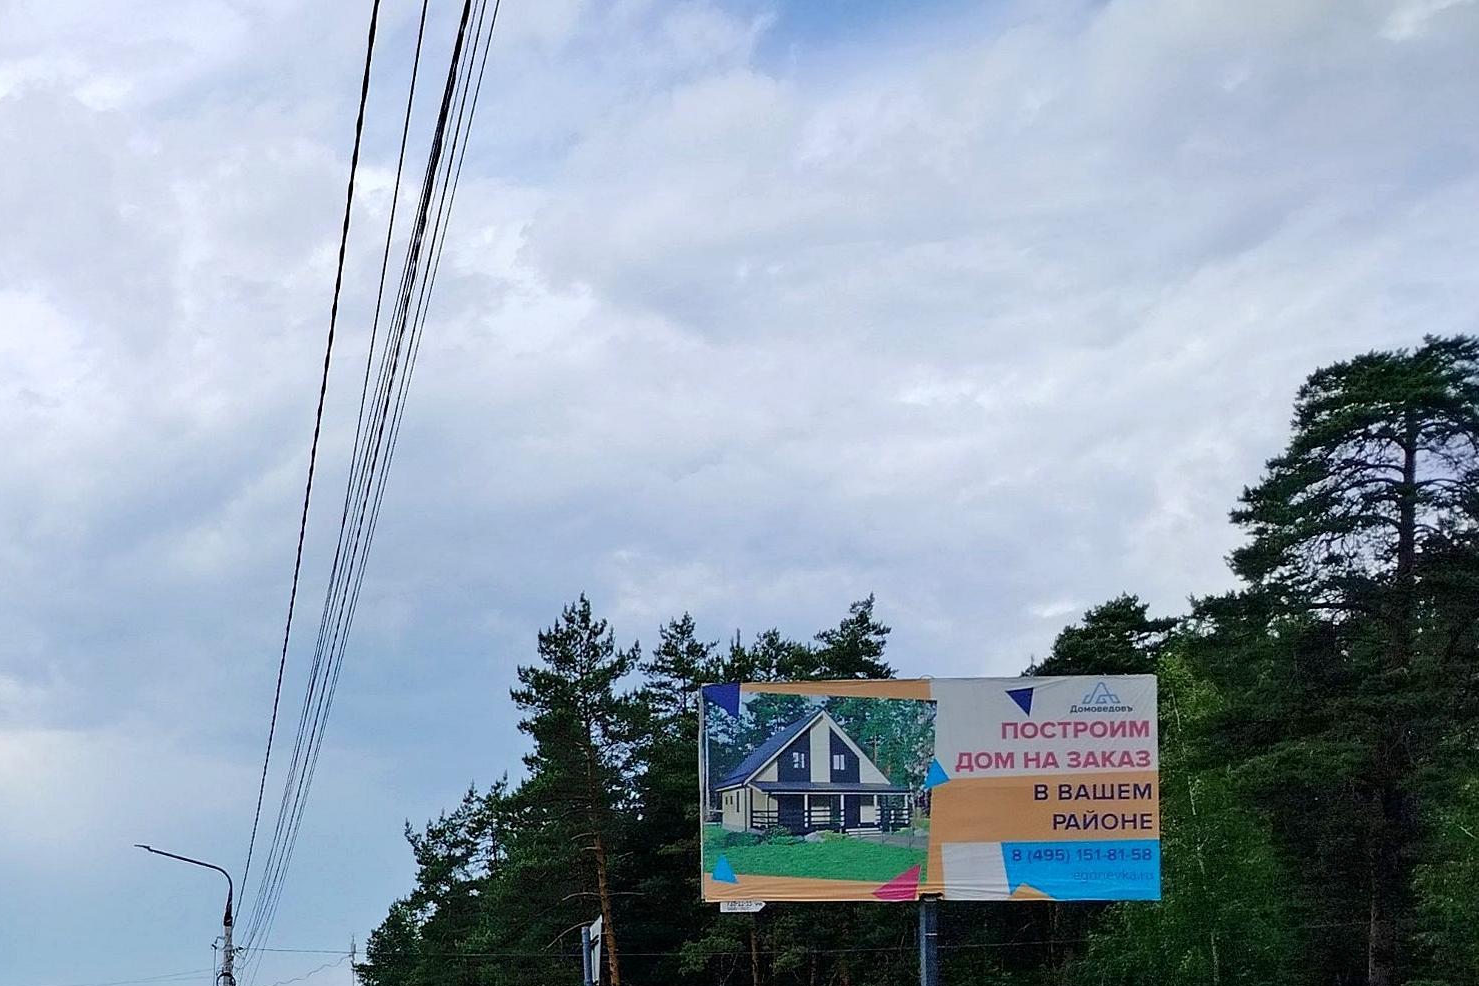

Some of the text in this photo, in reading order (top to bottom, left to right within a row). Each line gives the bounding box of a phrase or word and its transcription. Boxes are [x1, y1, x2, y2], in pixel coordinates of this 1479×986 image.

[1070, 704, 1133, 713] Домоведовъ
[1001, 720, 1150, 740] ПОСТРОИМ
[955, 750, 1151, 773] ДОМ НА ЗАКАЗ
[1034, 783, 1152, 801] В ВАШЕМ
[1053, 810, 1153, 830] РАЙОНЕ
[1012, 848, 1152, 864] 8 (495) 151-81-58
